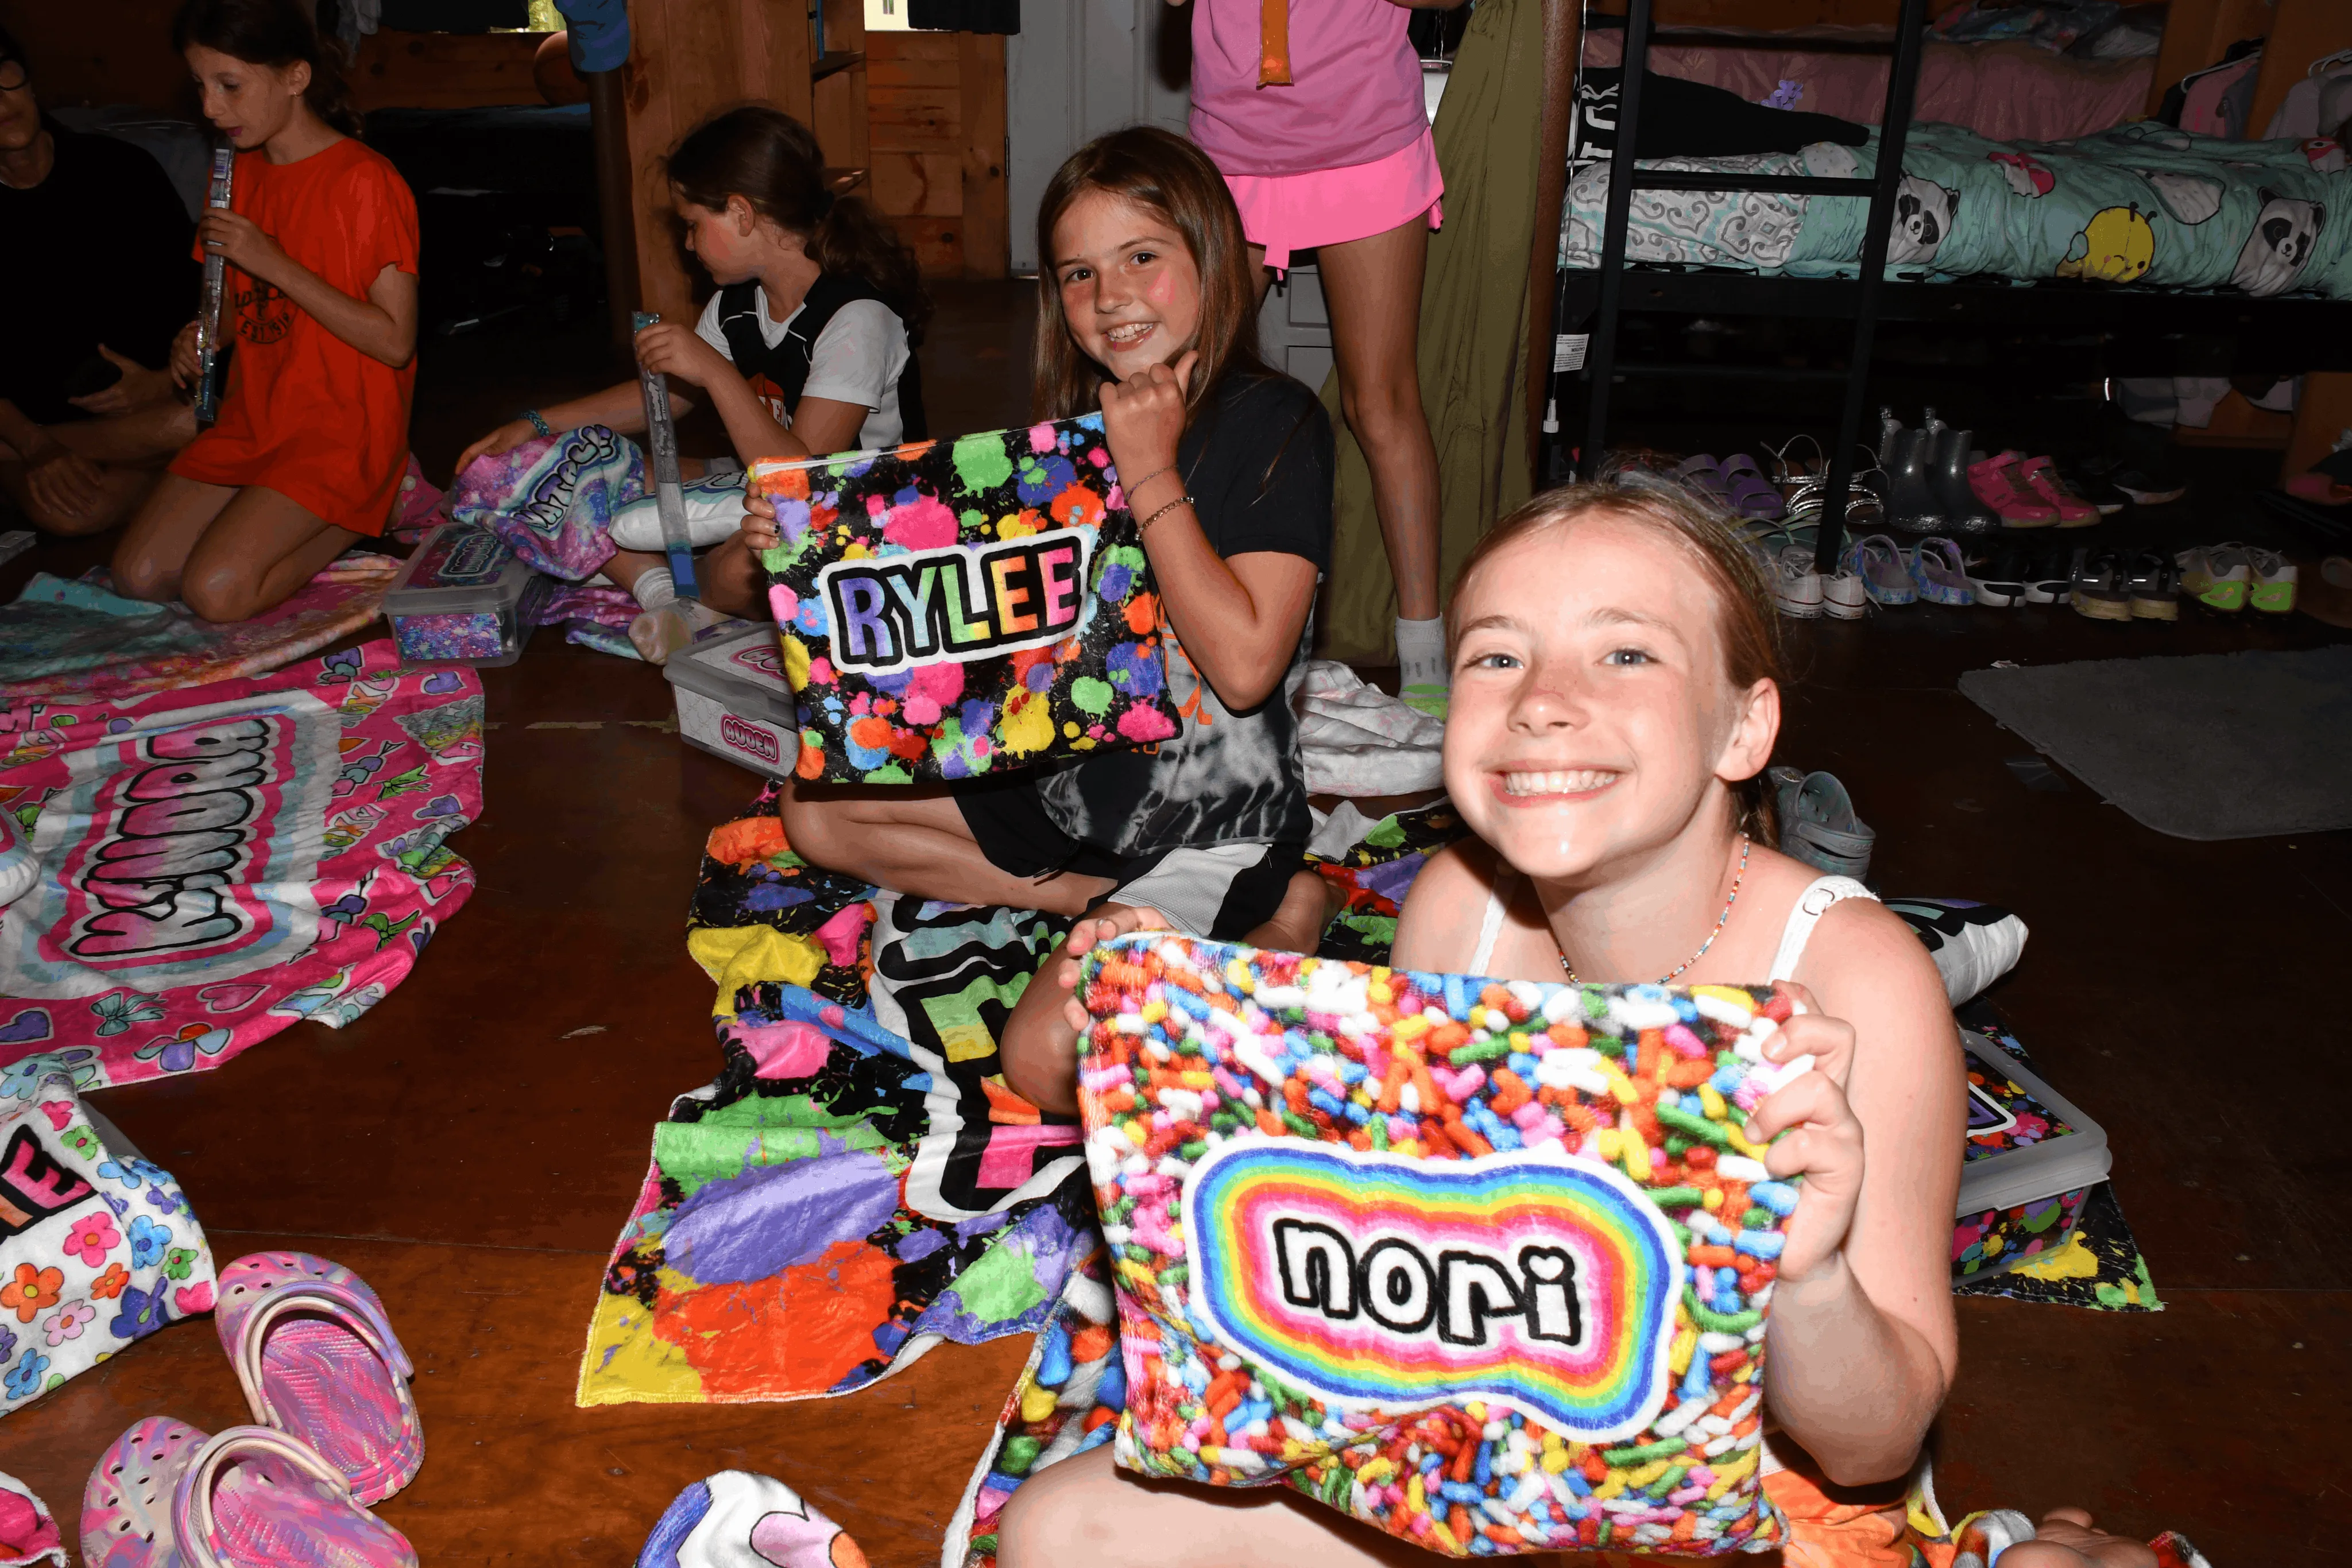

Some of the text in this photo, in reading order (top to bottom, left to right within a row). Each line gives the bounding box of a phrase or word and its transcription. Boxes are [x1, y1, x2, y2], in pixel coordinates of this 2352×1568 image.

[827, 535, 1084, 667] RYLEE
[725, 720, 776, 758] AUDEN
[70, 718, 270, 957] KENDRA
[1273, 1218, 1583, 1346] nori
